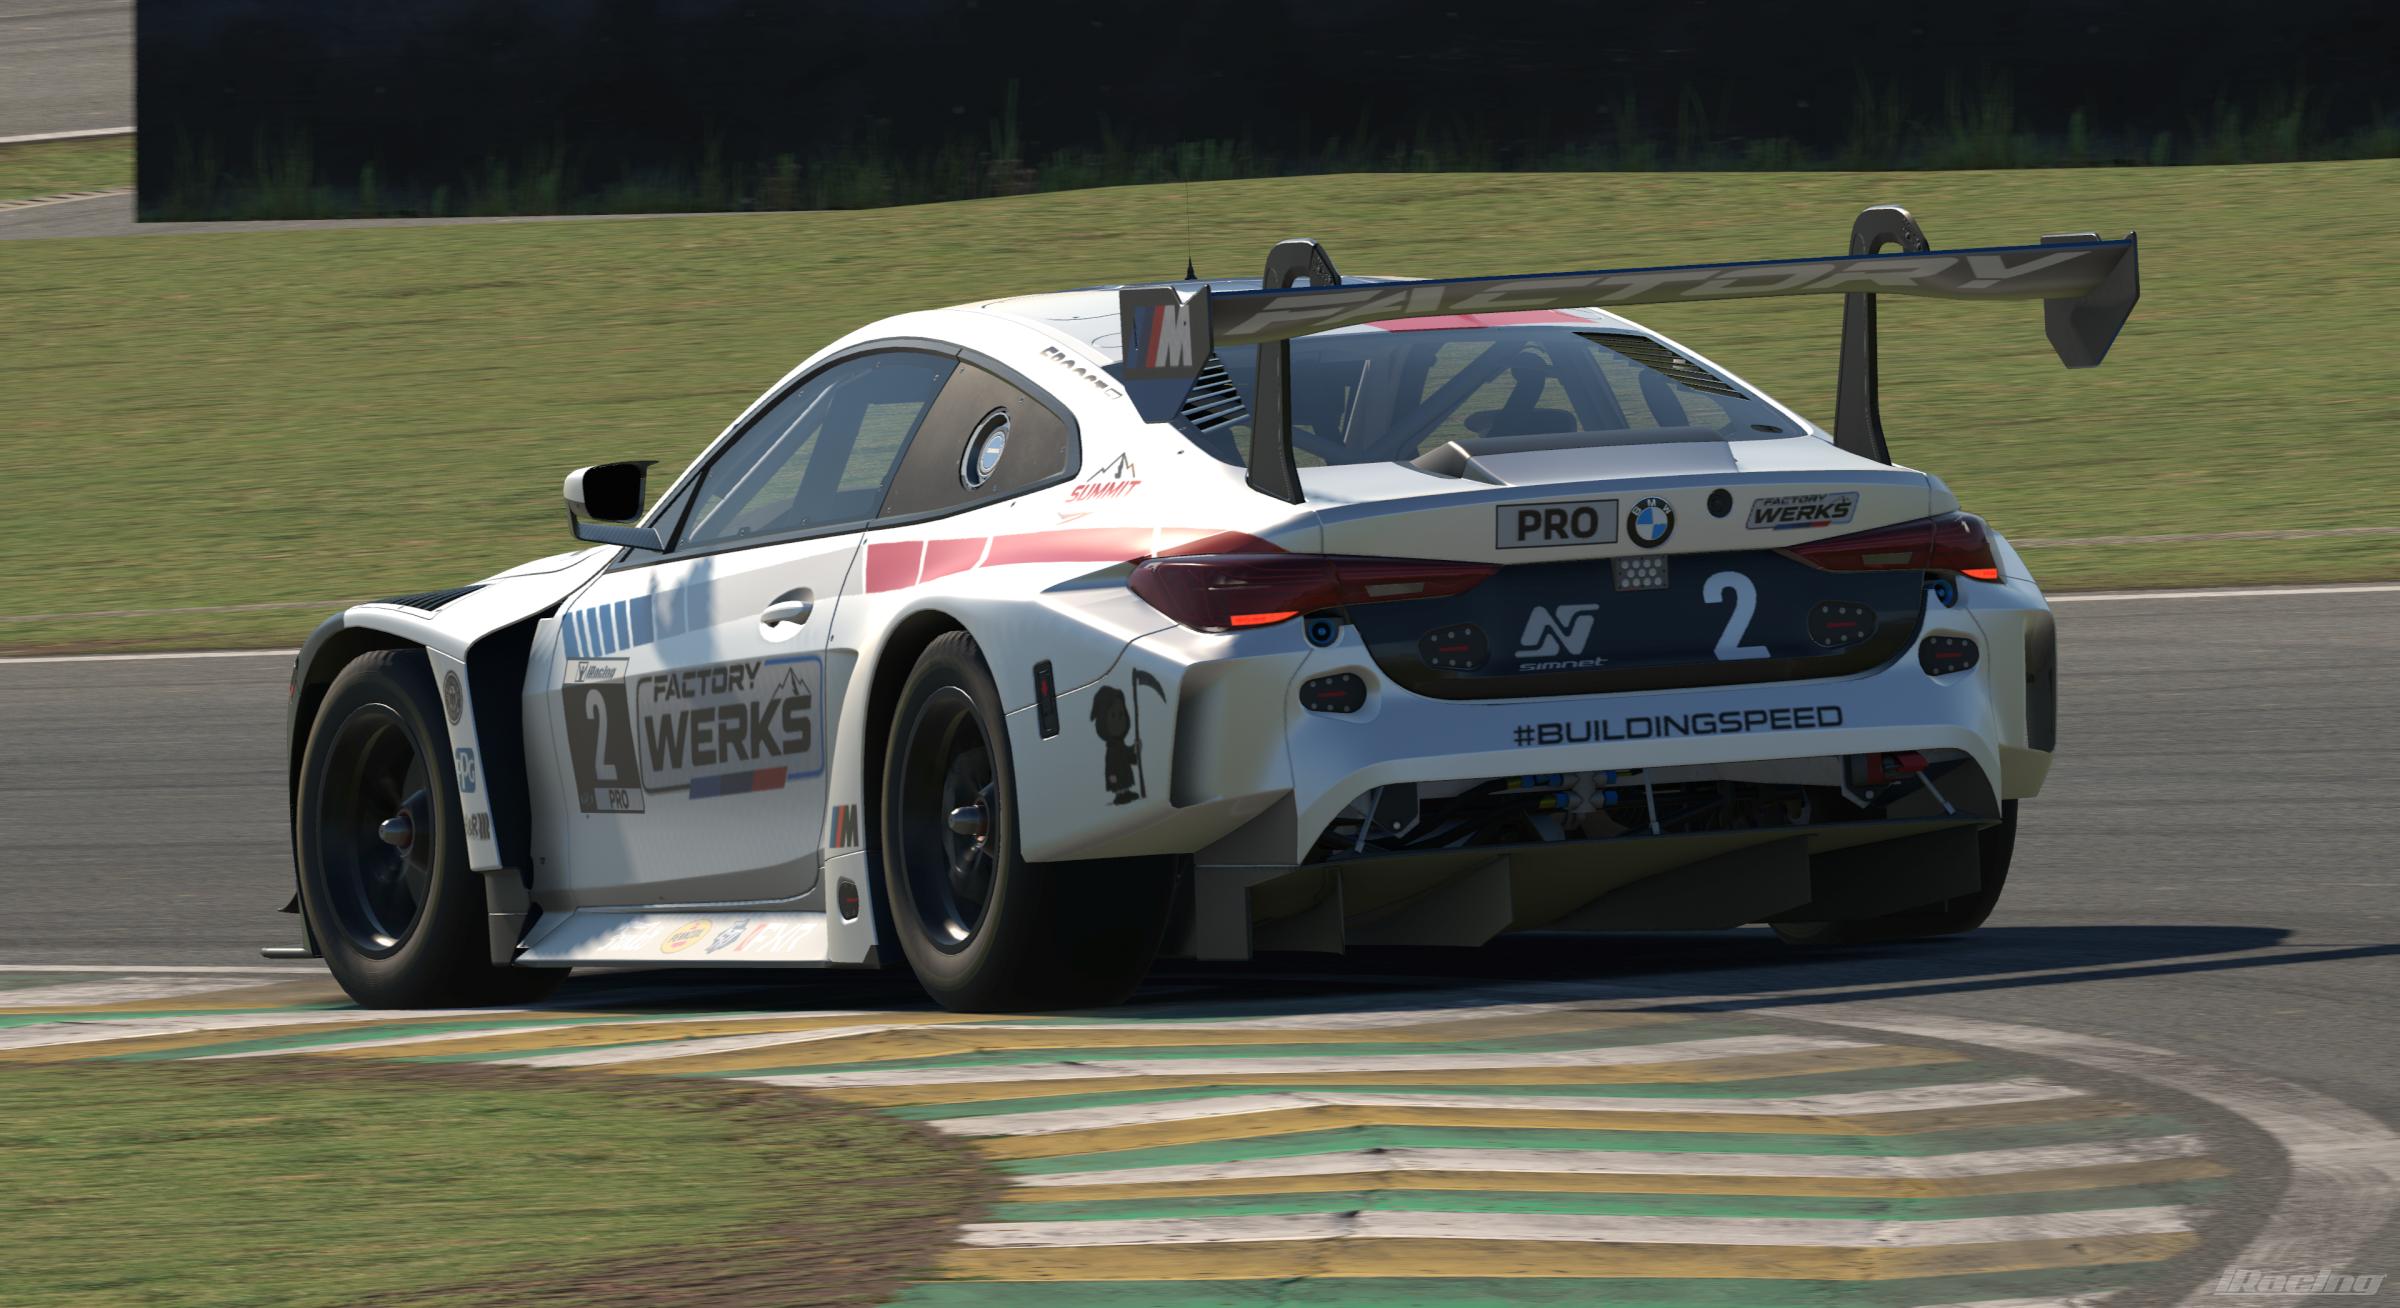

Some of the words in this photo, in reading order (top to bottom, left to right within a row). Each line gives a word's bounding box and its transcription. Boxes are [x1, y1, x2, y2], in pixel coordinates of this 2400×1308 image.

[1223, 251, 2092, 336] FACTORY
[1065, 480, 1142, 503] SUMMIT
[1763, 494, 1827, 506] FACTORY
[1517, 506, 1599, 542] PRO
[1755, 502, 1852, 524] WERKS
[1702, 571, 1771, 661] 2
[652, 661, 762, 703] FACTORY
[585, 689, 618, 782] 2
[644, 694, 812, 773] WERKS
[1513, 705, 1843, 747] #BUILDINGSPEED
[609, 790, 630, 809] PRO
